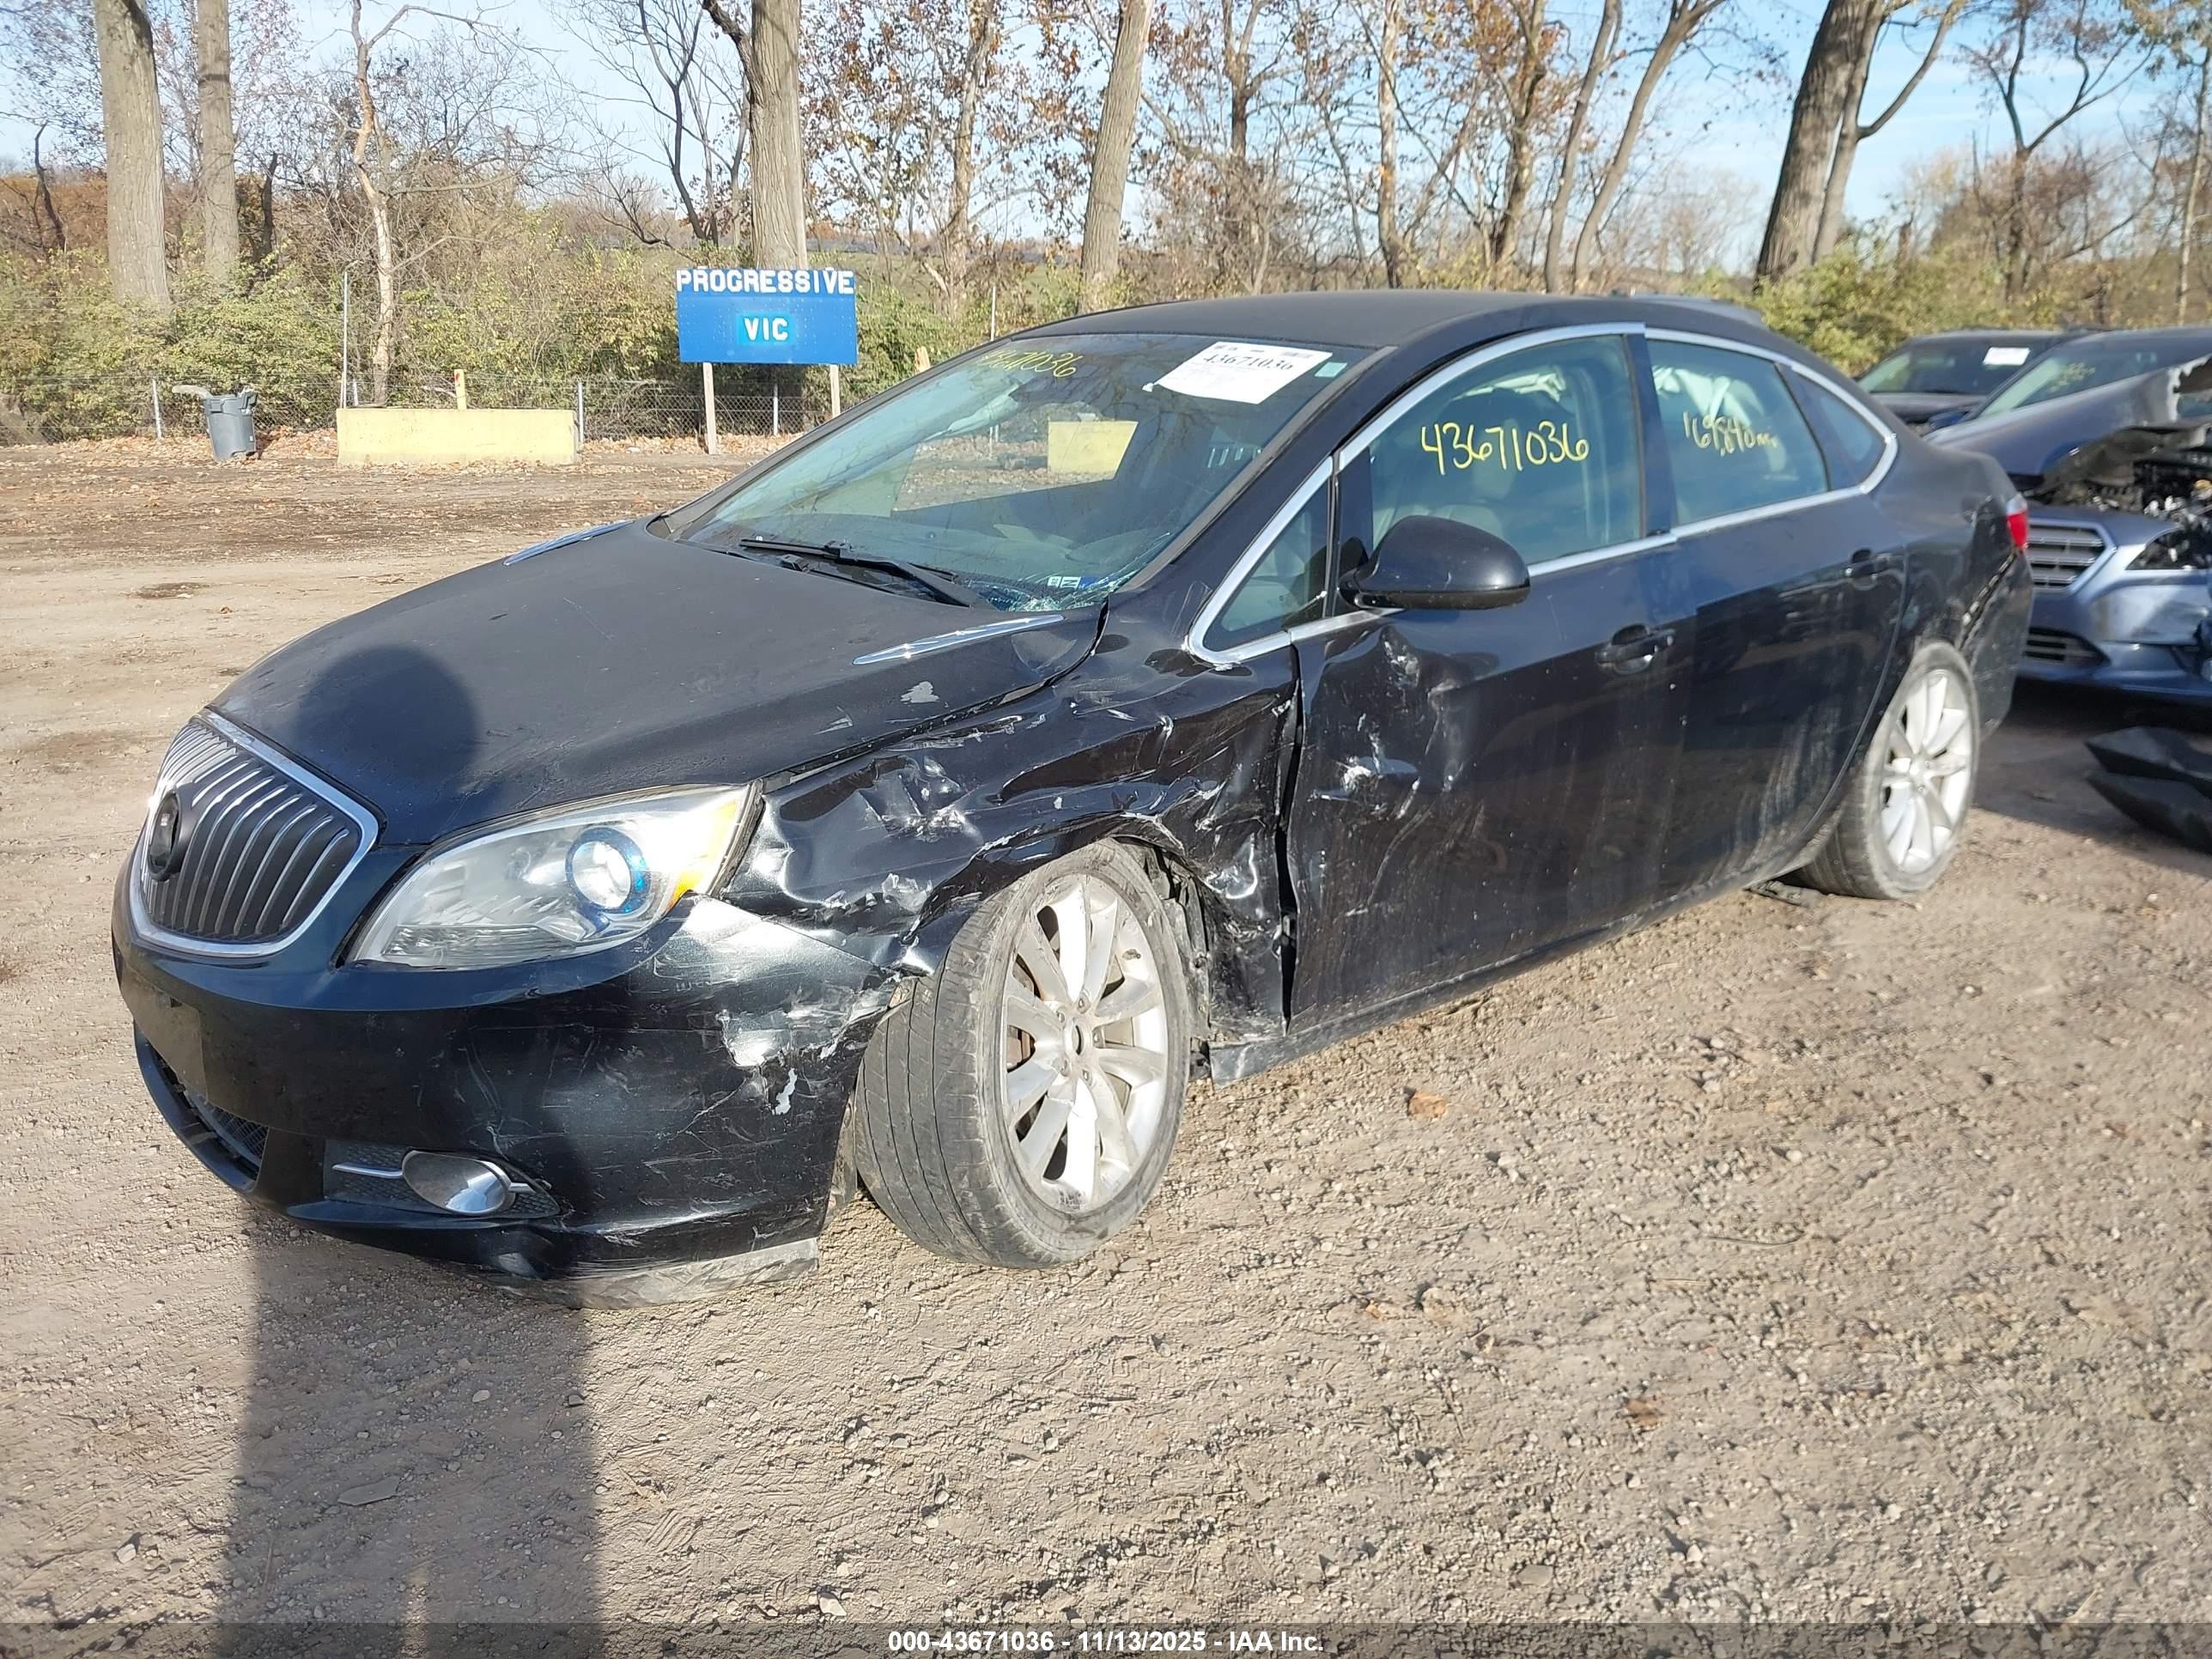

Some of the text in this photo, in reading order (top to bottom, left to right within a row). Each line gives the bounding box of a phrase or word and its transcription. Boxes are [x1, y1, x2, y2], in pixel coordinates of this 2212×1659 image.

[676, 270, 854, 294] PROGRESSIVE
[744, 318, 788, 341] VIC
[1421, 421, 1589, 476] 43671036
